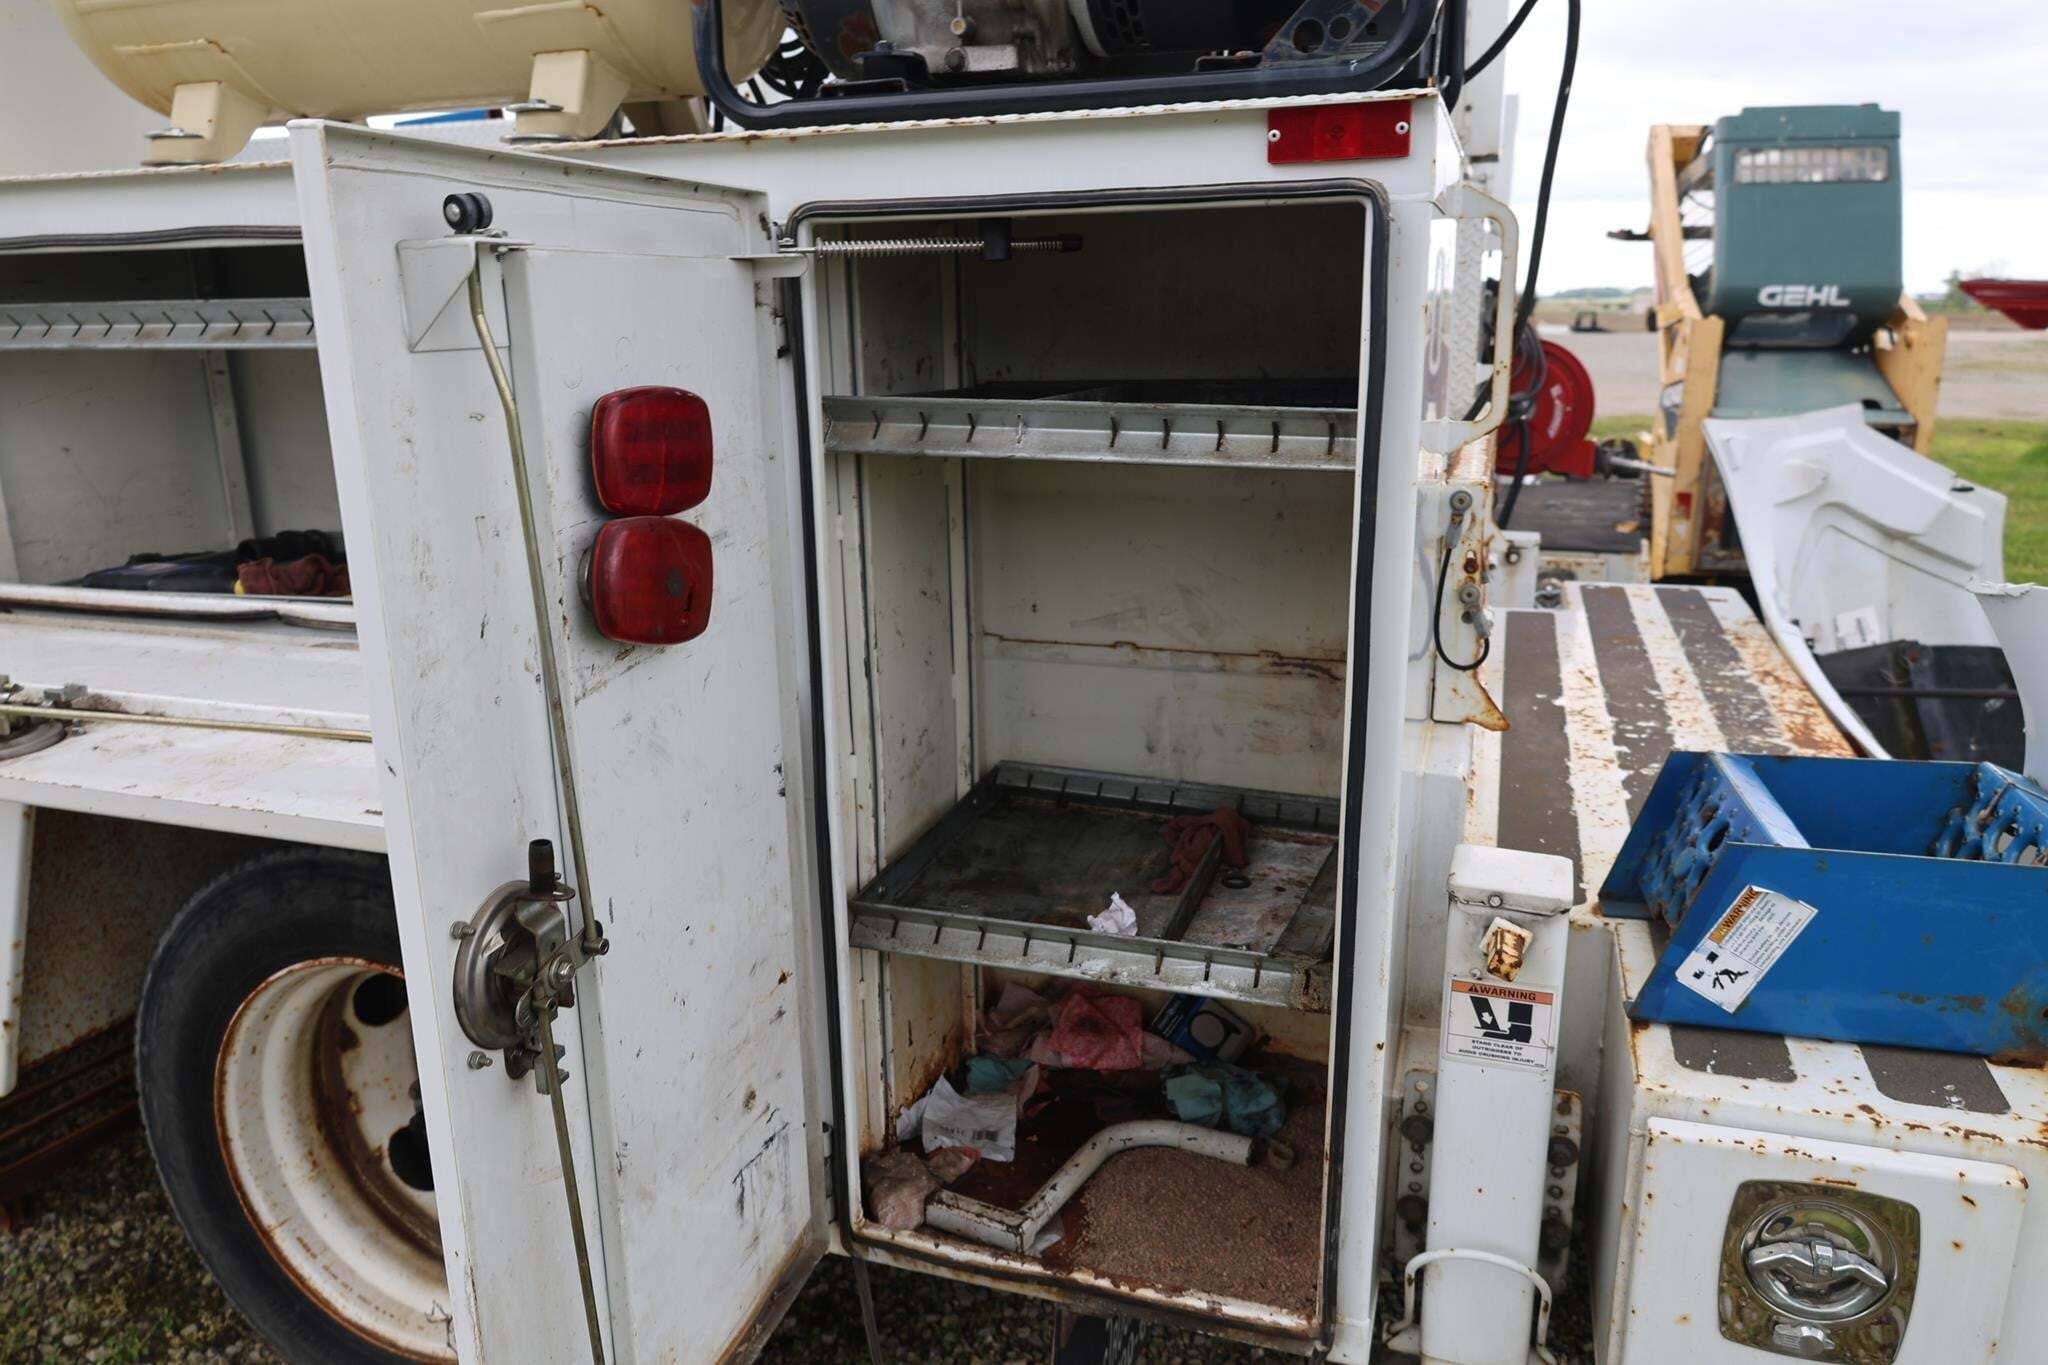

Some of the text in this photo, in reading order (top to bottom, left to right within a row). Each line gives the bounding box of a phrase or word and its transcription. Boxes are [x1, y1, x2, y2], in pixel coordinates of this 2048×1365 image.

[1758, 284, 1850, 307] GEHL
[1480, 985, 1536, 1001] WARNING
[1472, 1045, 1512, 1055] OUTRIGGERS
[1493, 1042, 1514, 1050] CLEAR
[1478, 1052, 1511, 1061] CRUSHING
